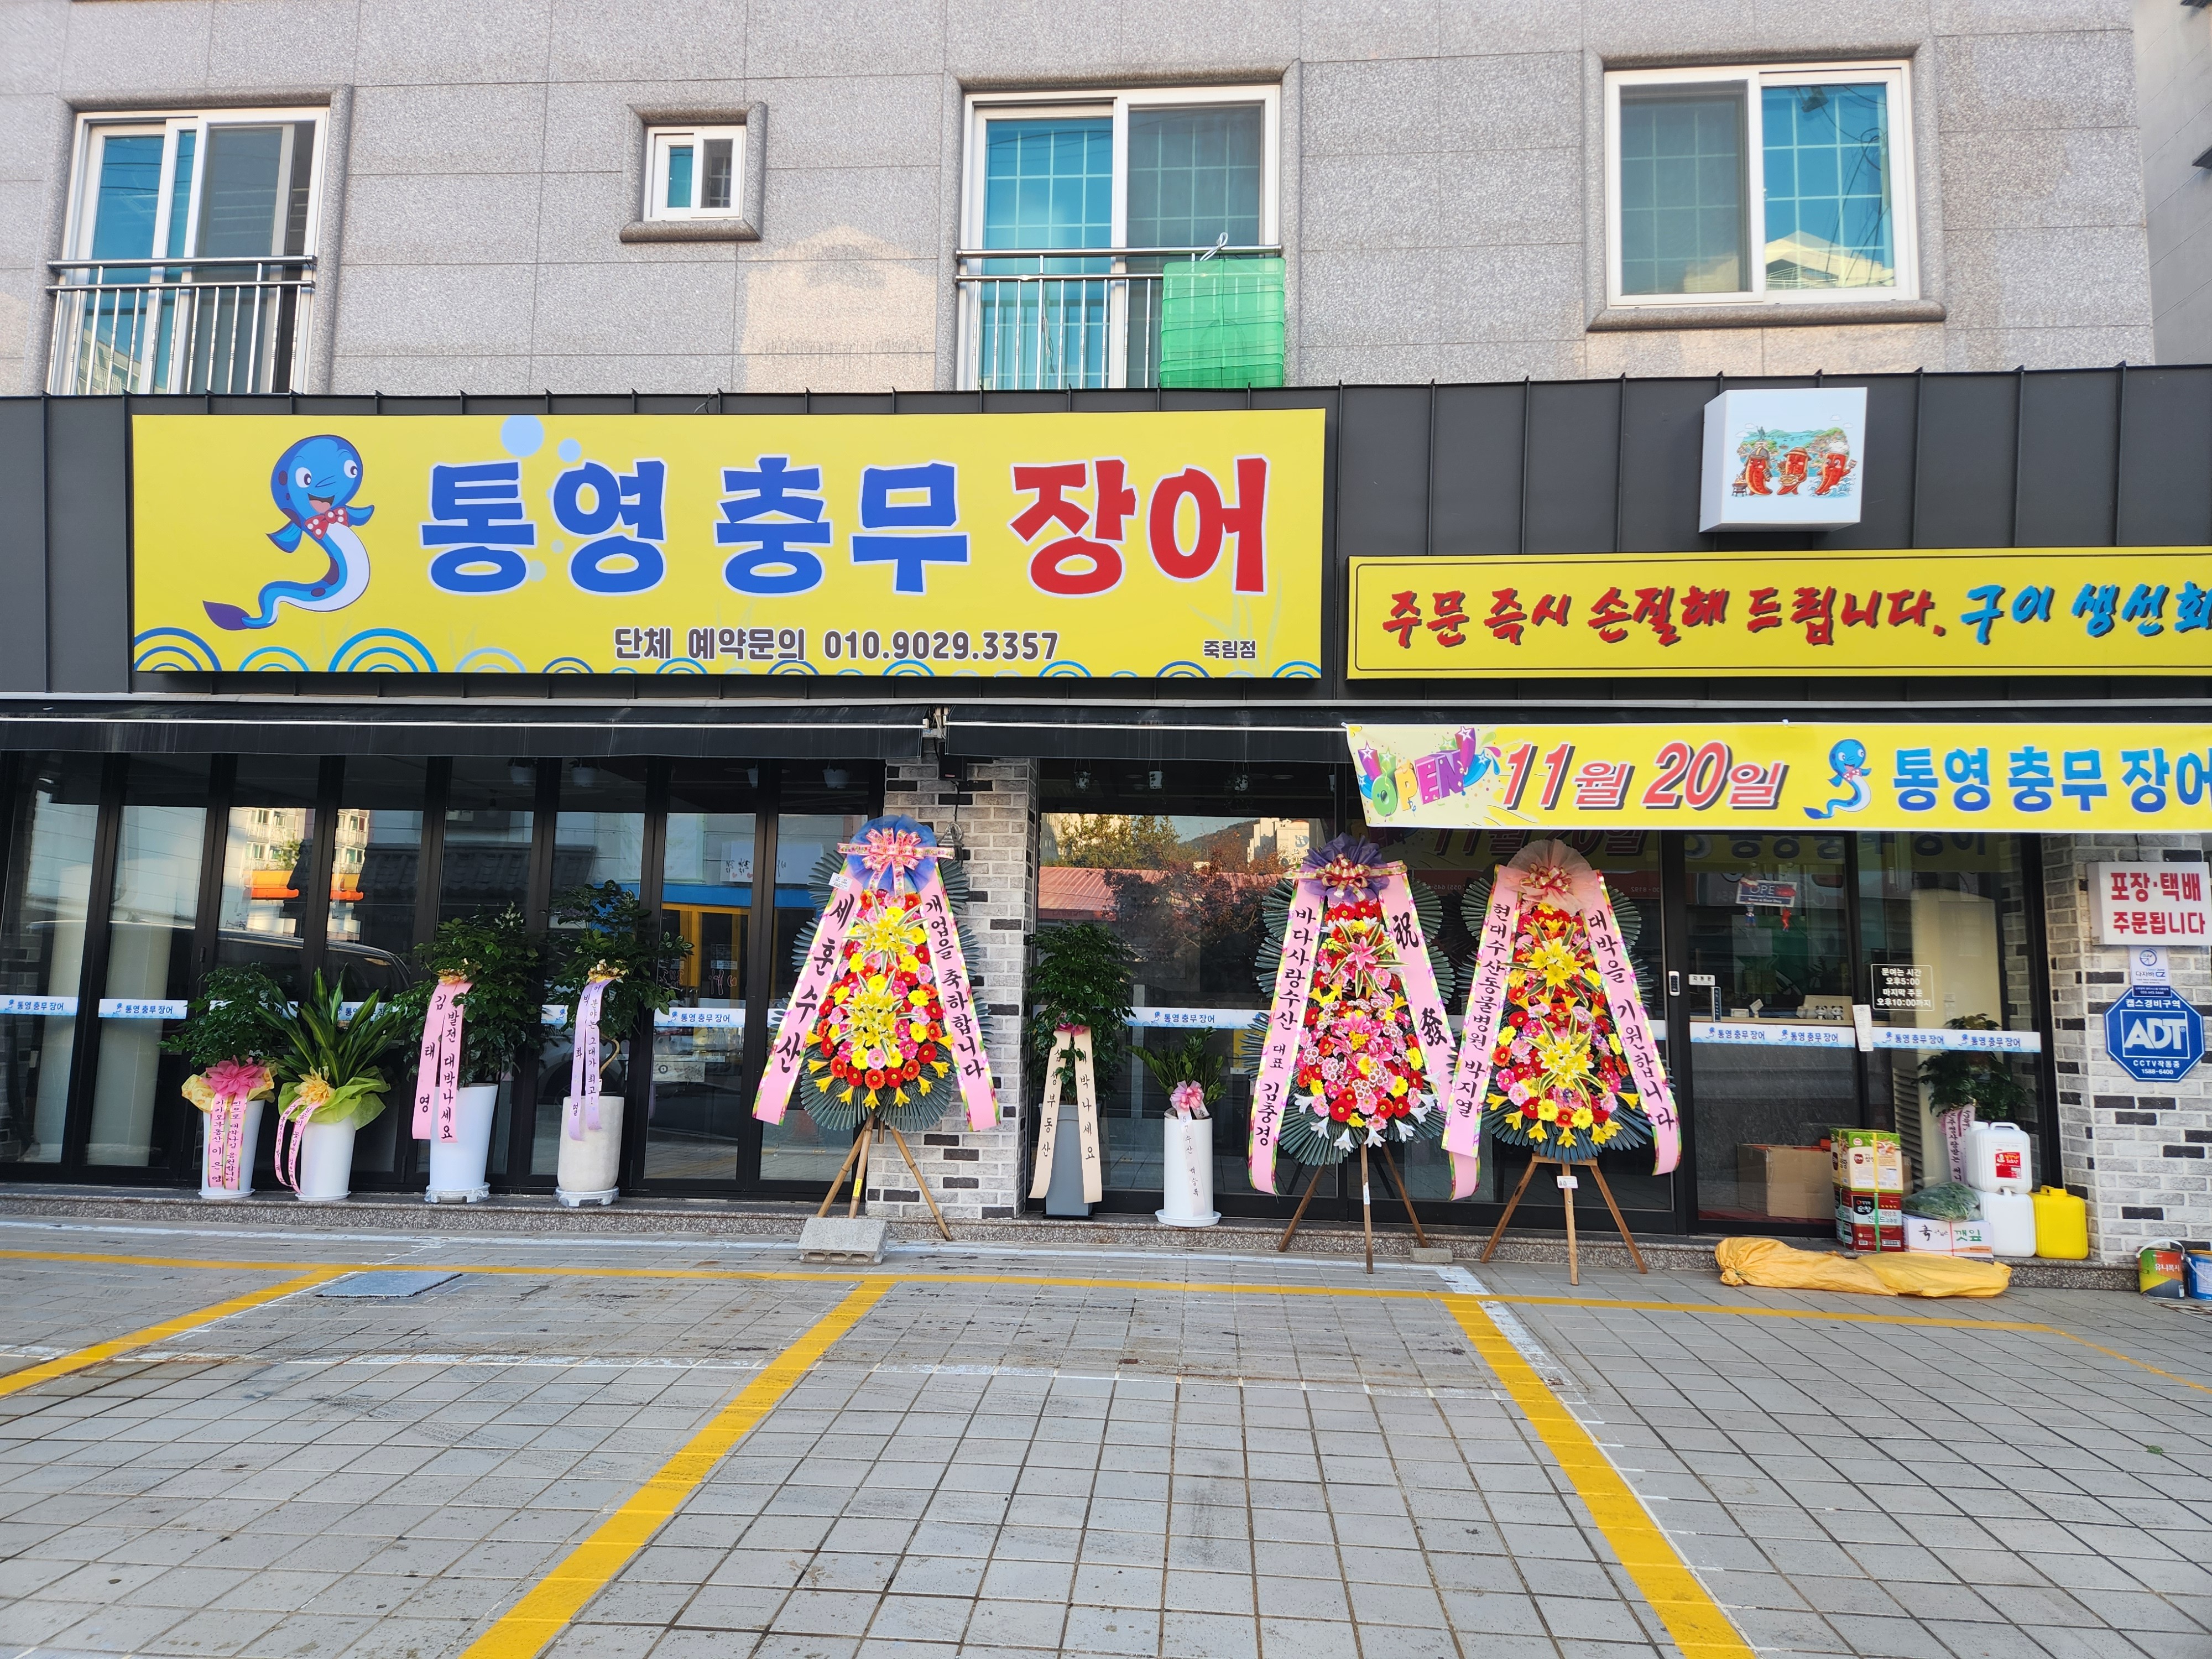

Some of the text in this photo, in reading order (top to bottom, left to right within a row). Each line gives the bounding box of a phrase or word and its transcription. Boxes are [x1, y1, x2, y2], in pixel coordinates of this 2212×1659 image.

[421, 455, 1269, 597] 통영 충무 장어
[1383, 581, 2212, 648] 주문 즉시 손질해 드립니다. 구이 생선회
[614, 627, 1058, 661] 단체 예약문의 010.9029.3357
[1203, 639, 1257, 660] 죽림점
[1371, 744, 1467, 818] OPEN
[1503, 741, 2212, 813] 11월 20일 통영 충무 장어
[2113, 911, 2205, 935] 주문됩니다
[776, 894, 855, 1073] 세훈수산
[1881, 968, 1922, 977] 문여는 시간
[1885, 977, 1921, 985] 오후5:00
[925, 894, 985, 1081] 개업을 축하합니다
[1882, 988, 1923, 997] 마지막 주문
[17, 1001, 64, 1011] 통영 충무 장어
[125, 1005, 173, 1014] 통영 충무 장어
[1455, 902, 1511, 1119] 현대수산동물병원 박지열
[1876, 998, 1932, 1008] 오후10:00까지
[2125, 998, 2181, 1009] 캡스경비구역
[681, 1014, 730, 1023] 통영 충무 장어
[1164, 1013, 1215, 1023] 통영 충무 장어
[1255, 906, 1317, 1147] 바다사랑수산 대표 김충경
[1587, 909, 1676, 1133] 대박을 기원합니다
[1718, 1029, 1765, 1040] 통영 충무 장어
[1791, 1031, 1839, 1042] 통영 충무 장어
[1895, 1033, 1944, 1045] 통영 충무 장어
[1970, 1036, 2020, 1047] 통영 충무 장어
[2124, 1018, 2187, 1050] ADT
[419, 994, 447, 1113] 김태영
[588, 1037, 597, 1068] 그대가
[2132, 1059, 2180, 1068] CCTV작동중
[441, 1009, 460, 1139] 발전 대박나세요
[588, 1074, 597, 1105] 최고!
[1041, 1047, 1062, 1157] 삼성부동산
[1953, 1229, 1983, 1242] 깻잎
